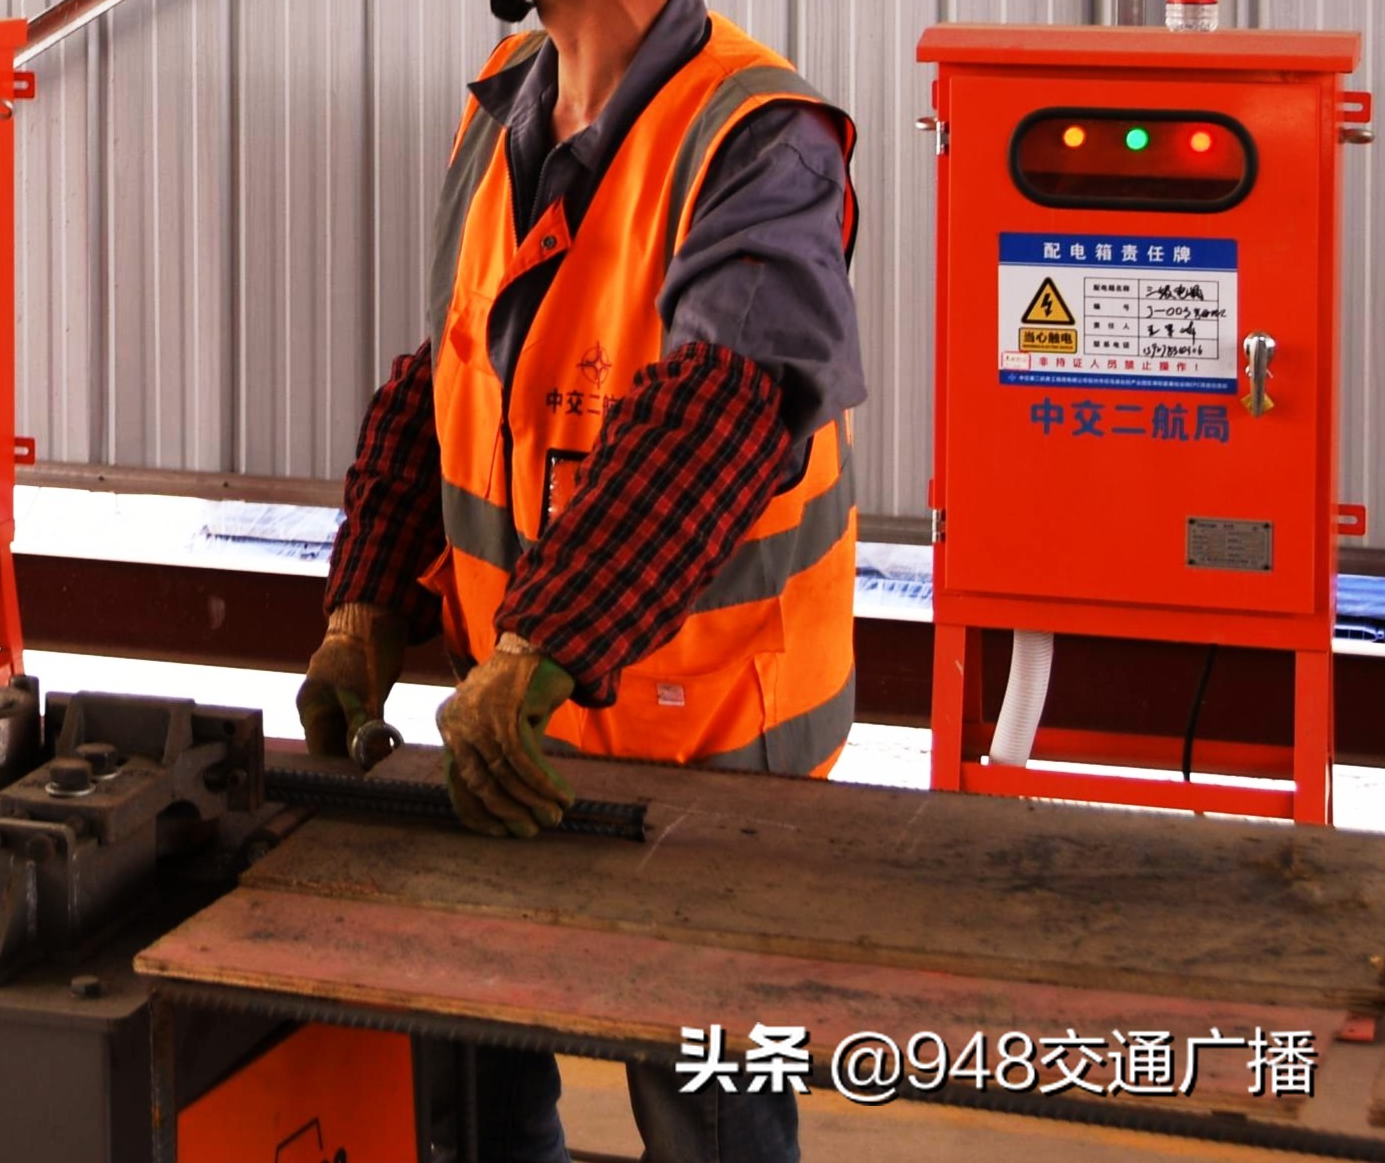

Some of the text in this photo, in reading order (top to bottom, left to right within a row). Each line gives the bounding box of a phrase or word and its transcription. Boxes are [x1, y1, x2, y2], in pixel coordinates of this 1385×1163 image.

[1043, 242, 1191, 263] 配电箱责任牌
[1023, 331, 1073, 344] 当心触电
[1030, 396, 1231, 443] 中交二航局
